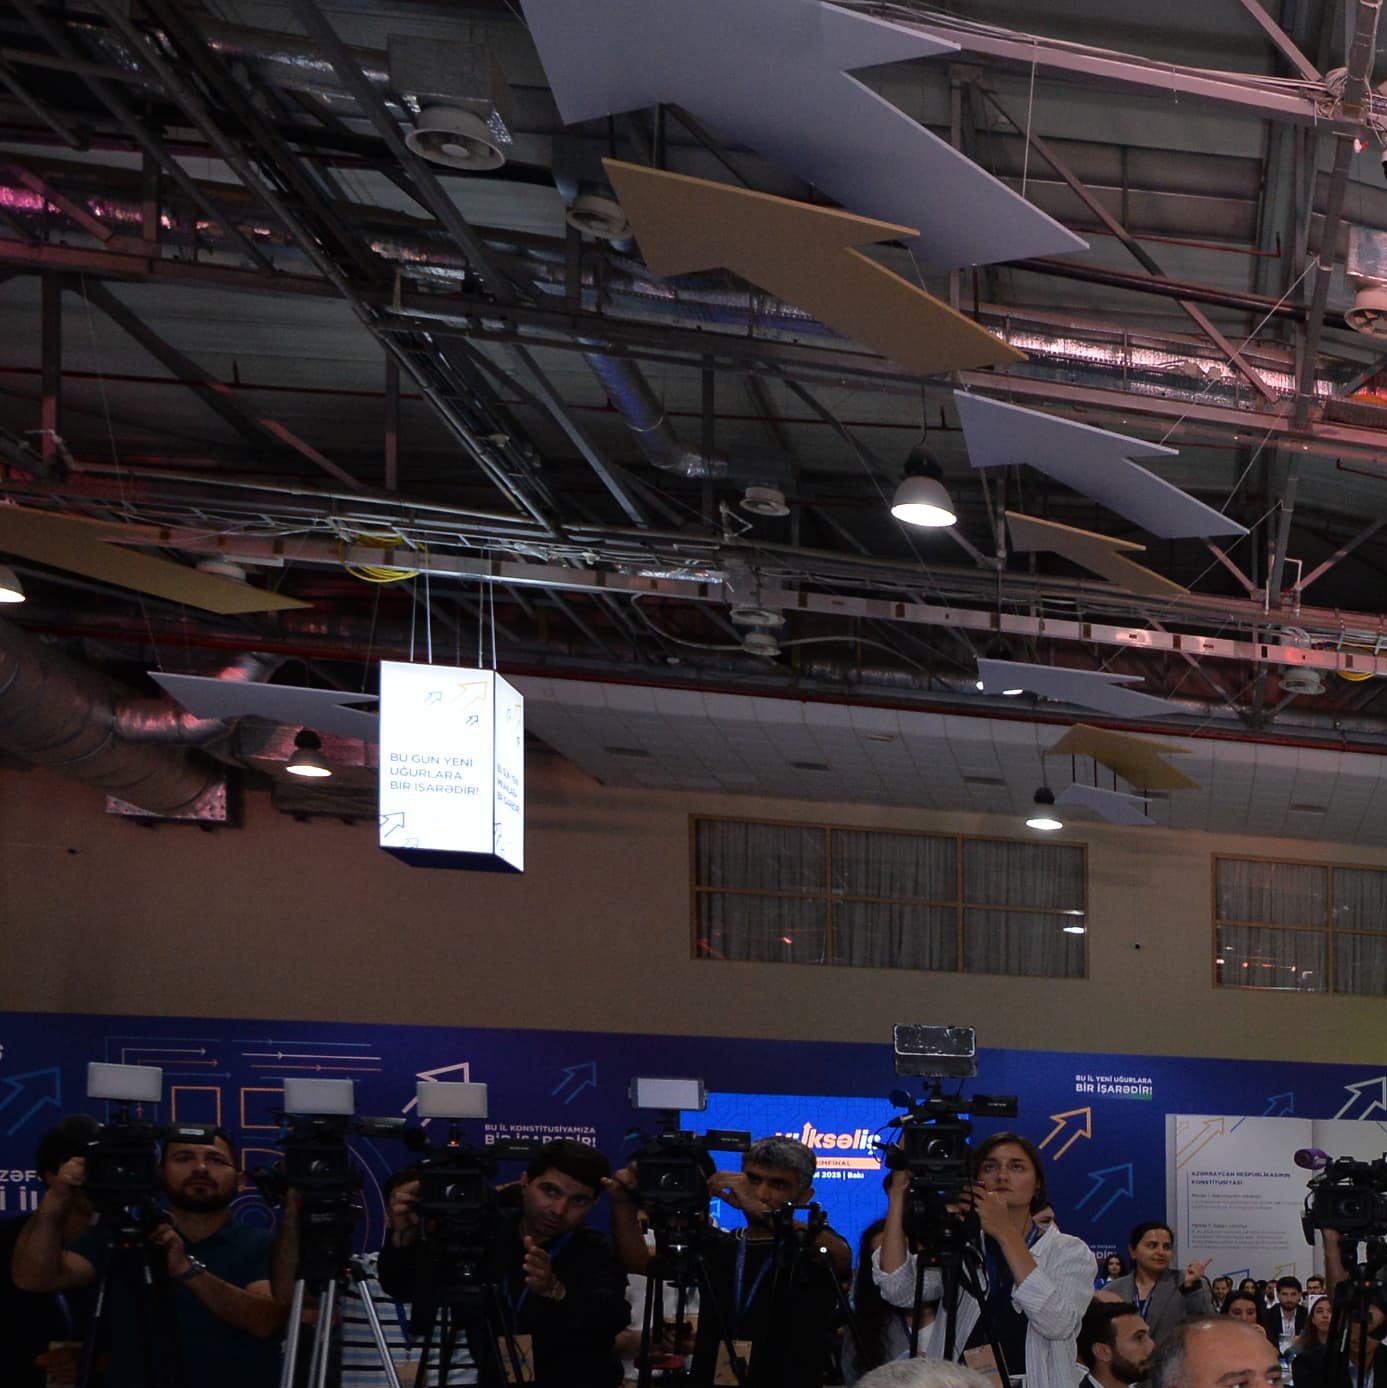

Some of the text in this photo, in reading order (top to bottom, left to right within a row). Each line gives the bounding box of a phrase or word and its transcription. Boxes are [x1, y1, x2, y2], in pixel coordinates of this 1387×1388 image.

[390, 752, 408, 762] BU
[444, 756, 473, 767] YENİ
[1076, 1082, 1153, 1095] BİR İŞARƏDİR!
[500, 1123, 508, 1131] İL
